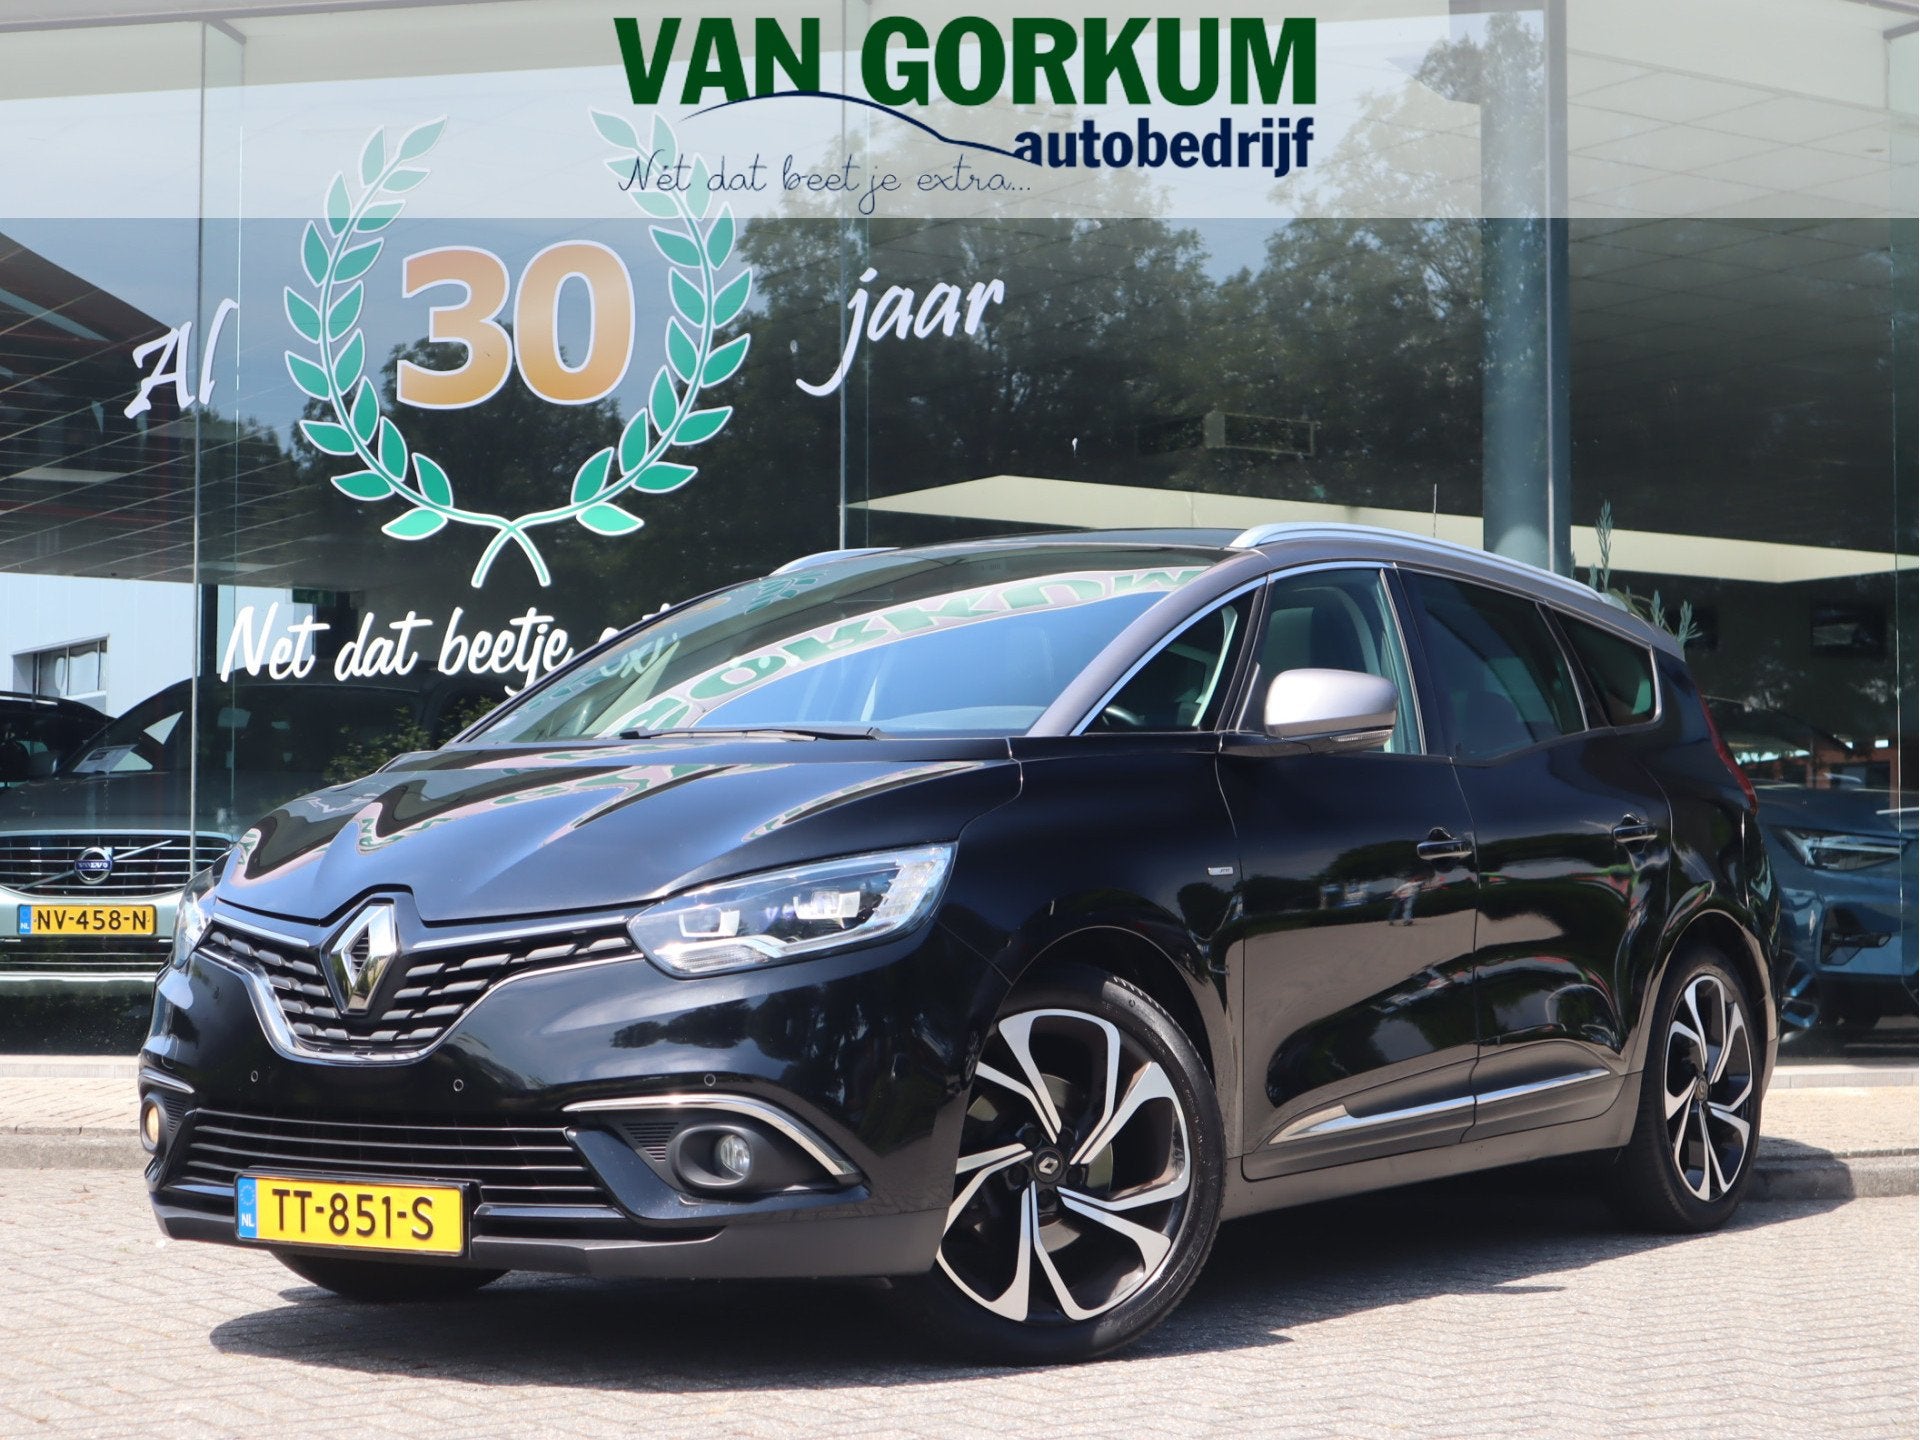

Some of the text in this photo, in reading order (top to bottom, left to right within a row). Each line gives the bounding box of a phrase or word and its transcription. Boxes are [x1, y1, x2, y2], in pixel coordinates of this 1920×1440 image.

[124, 240, 1005, 419] Al 30 jaar
[220, 602, 331, 682] Net
[334, 610, 432, 682] dat
[437, 606, 574, 698] beetje
[36, 909, 147, 931] NV-458-N
[240, 1213, 256, 1228] NL
[271, 1187, 435, 1241] TT-851-S
